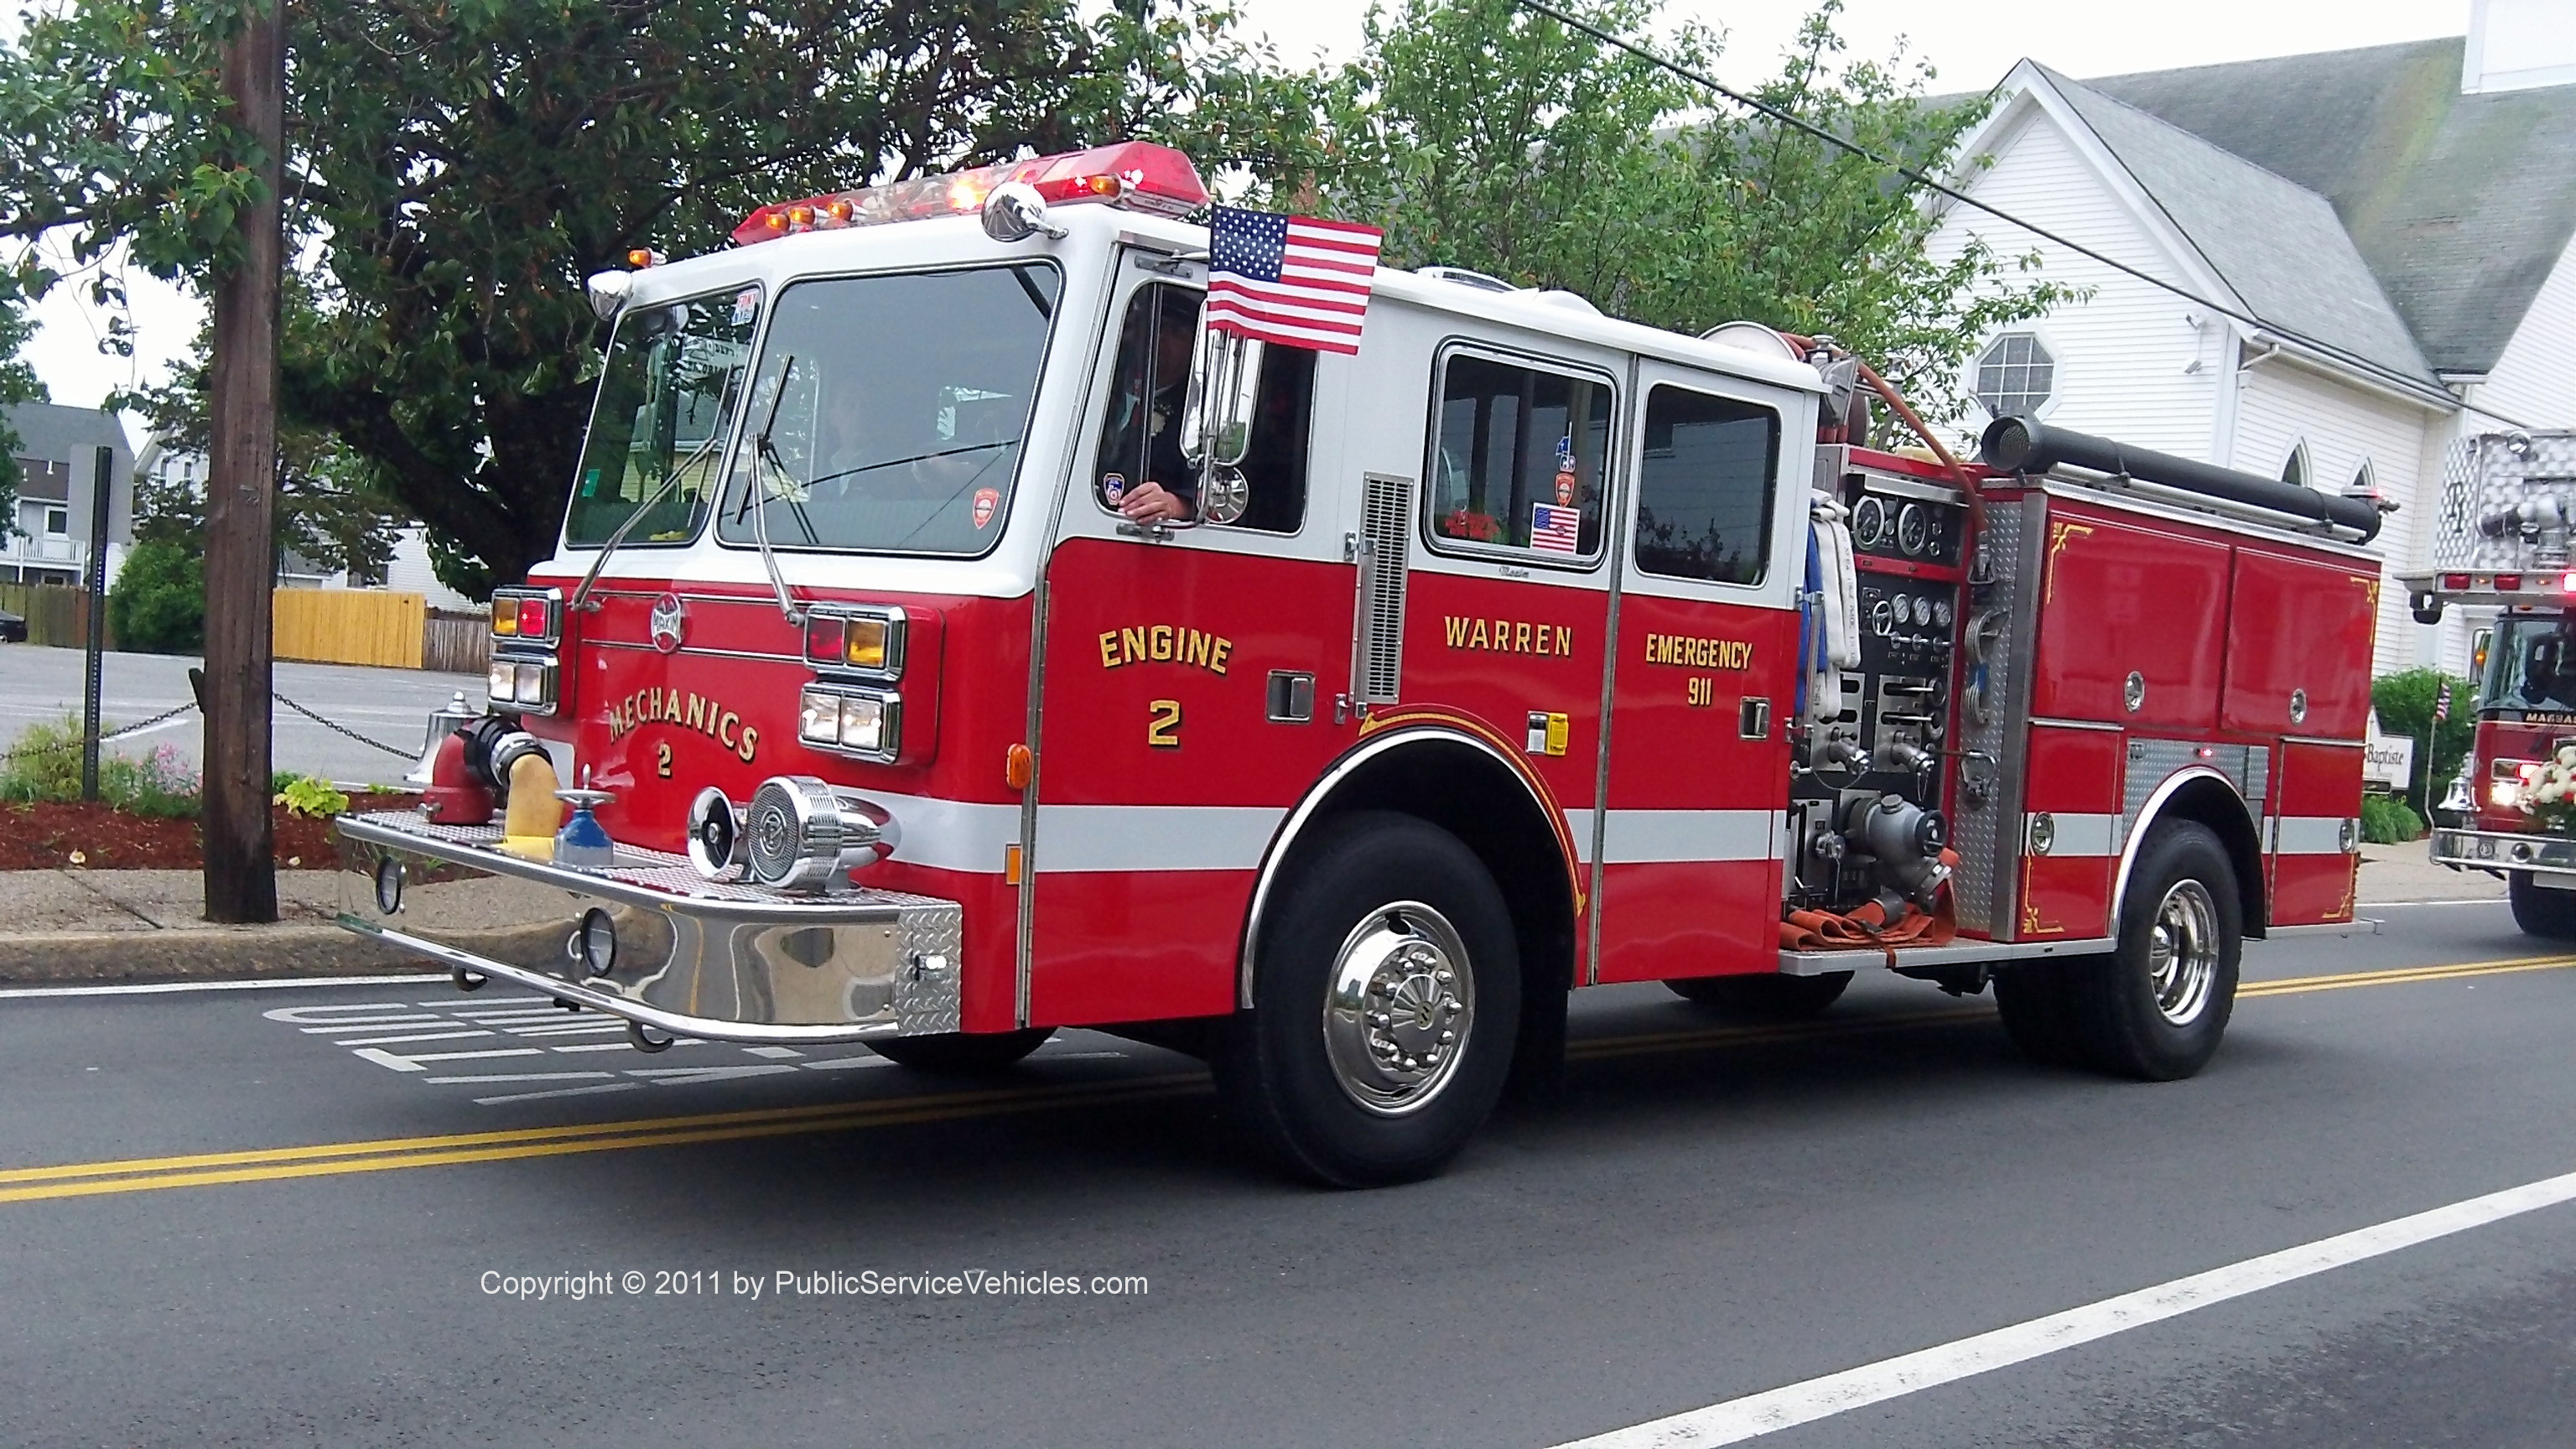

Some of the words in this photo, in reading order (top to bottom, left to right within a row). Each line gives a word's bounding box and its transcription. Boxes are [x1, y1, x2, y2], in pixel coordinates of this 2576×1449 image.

[1099, 625, 1232, 675] ENGINE
[1445, 615, 1572, 657] WARREN
[1645, 633, 1753, 670] EMERGENCY
[1688, 678, 1712, 707] 911
[610, 687, 759, 764] MECHANICS
[1148, 699, 1180, 747] 2
[658, 743, 671, 777] 2
[2366, 743, 2404, 772] Baptiste
